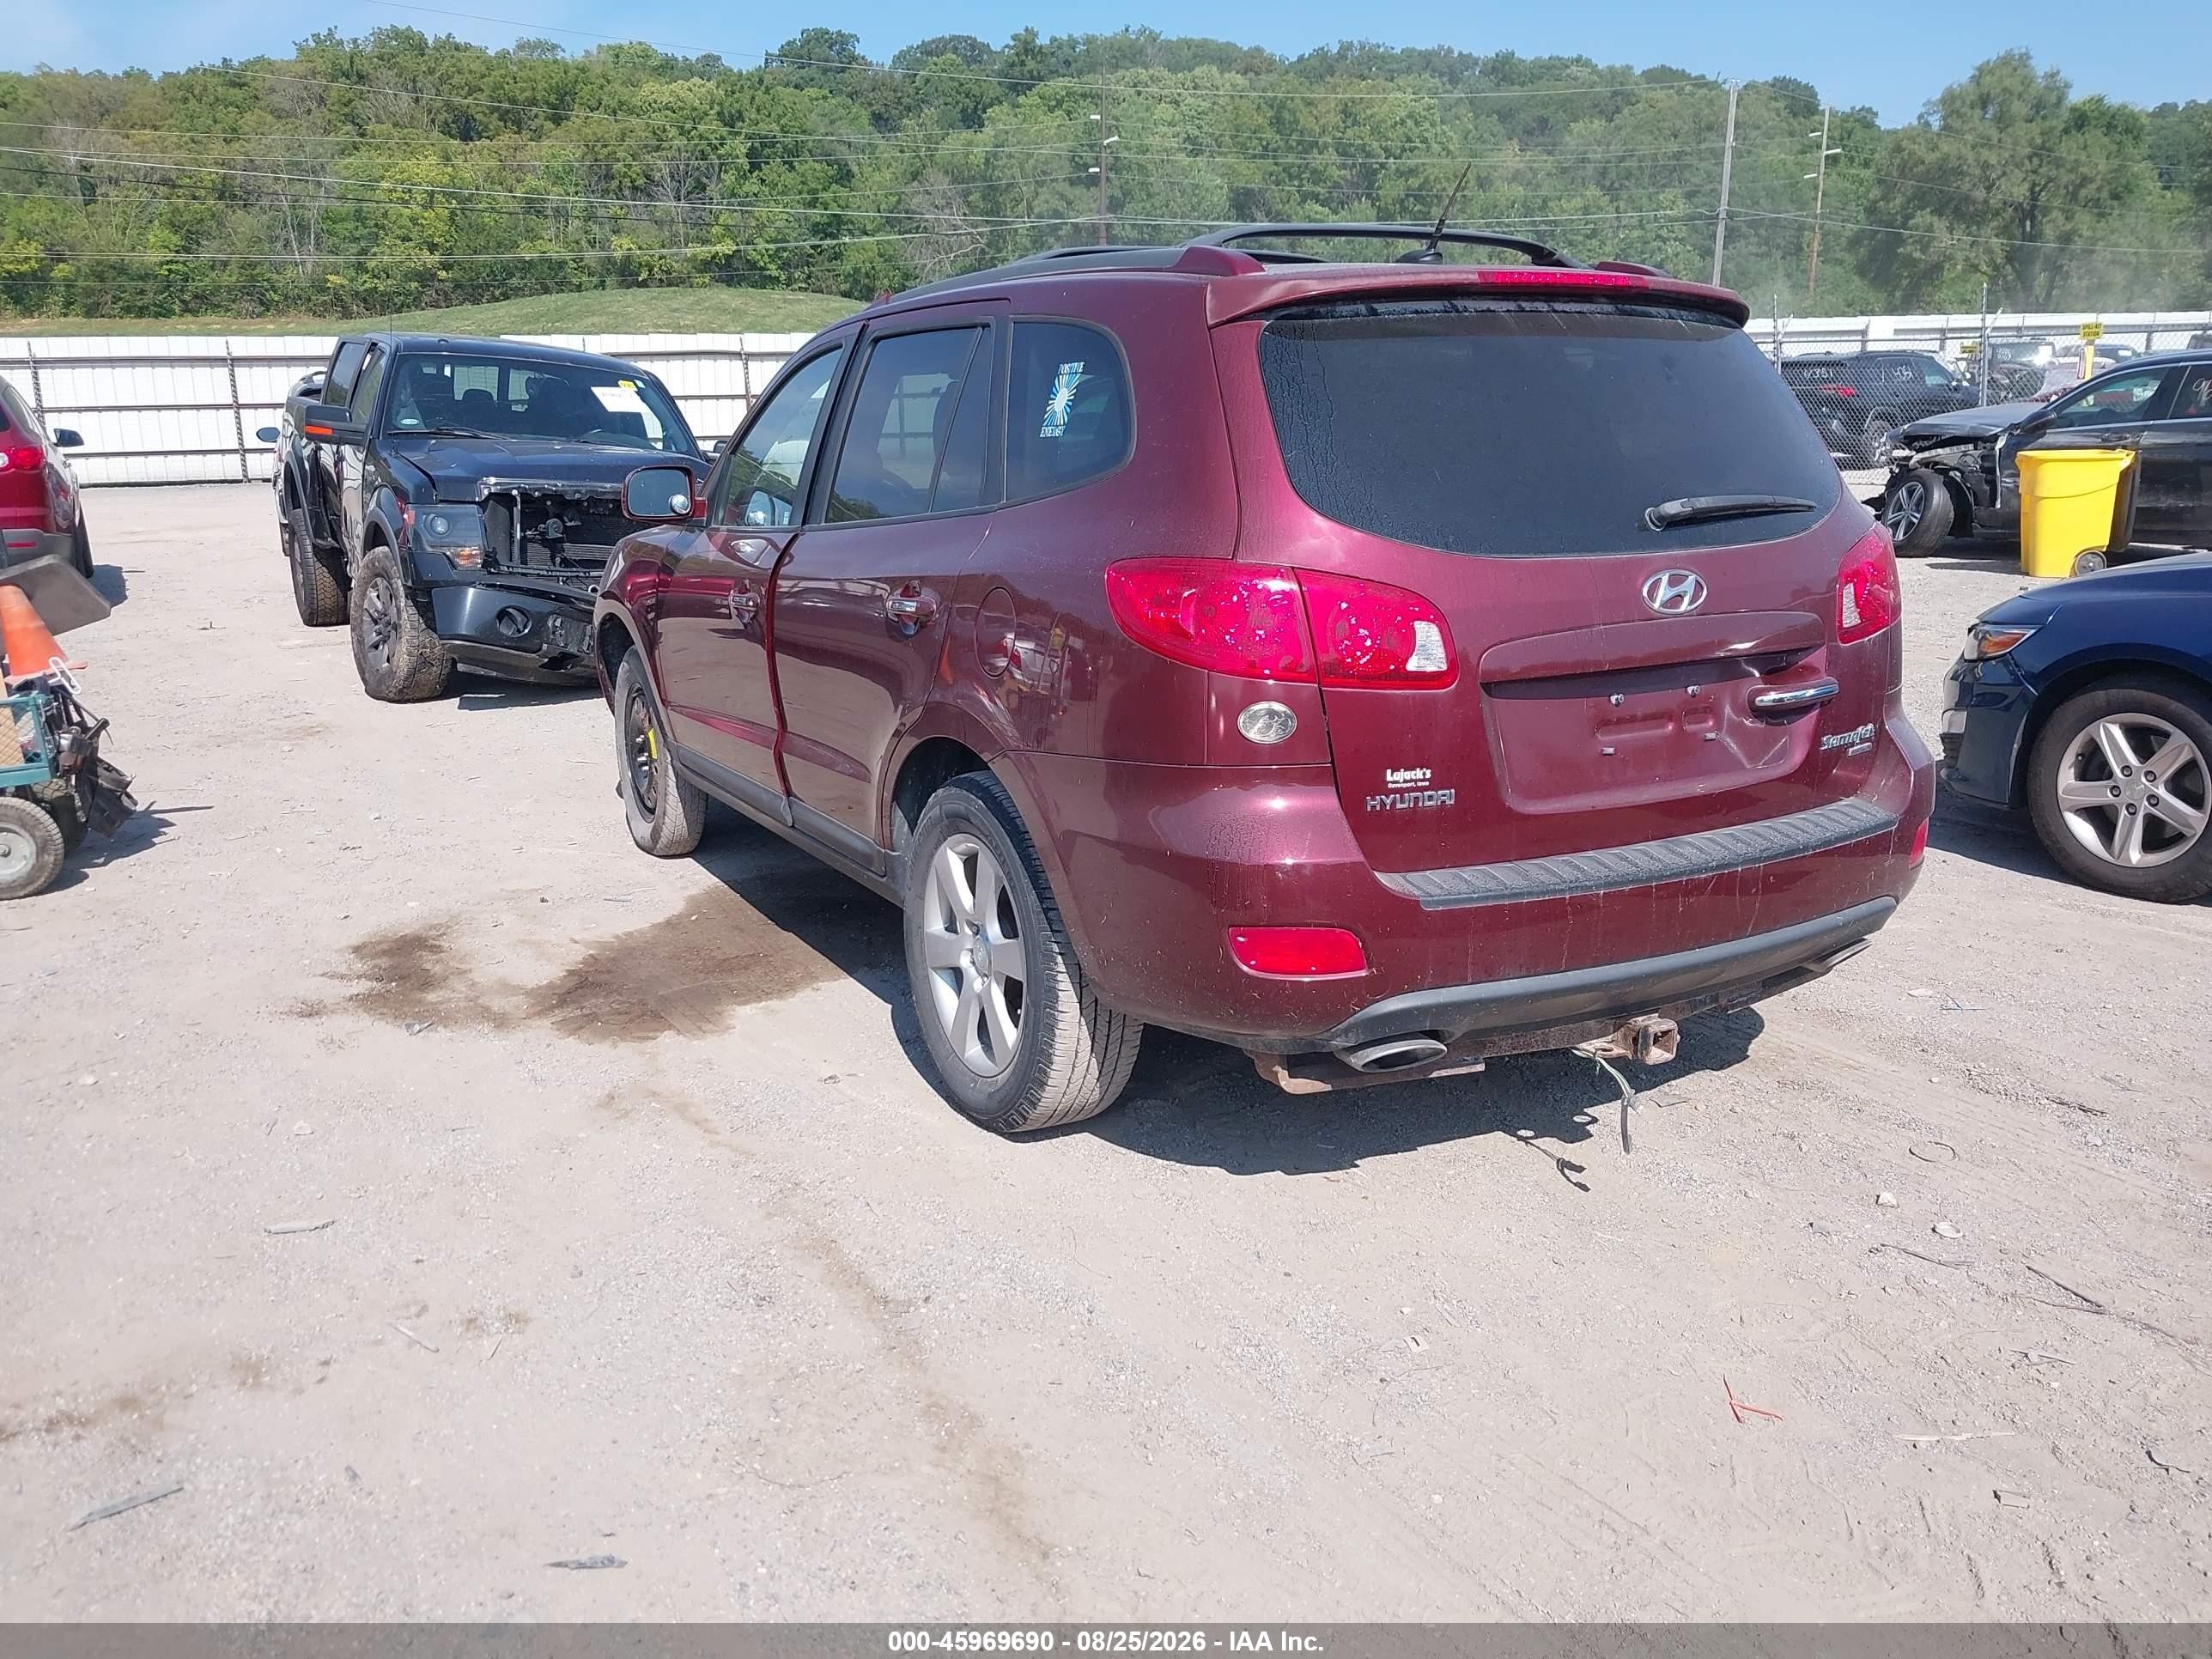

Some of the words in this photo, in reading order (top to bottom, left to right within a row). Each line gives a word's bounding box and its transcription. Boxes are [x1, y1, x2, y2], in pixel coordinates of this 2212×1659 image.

[1057, 362, 1085, 374] POSITIVE
[1039, 425, 1066, 438] ENERGY
[1386, 768, 1432, 782] Lajack's
[1365, 788, 1456, 812] HYUNDAI
